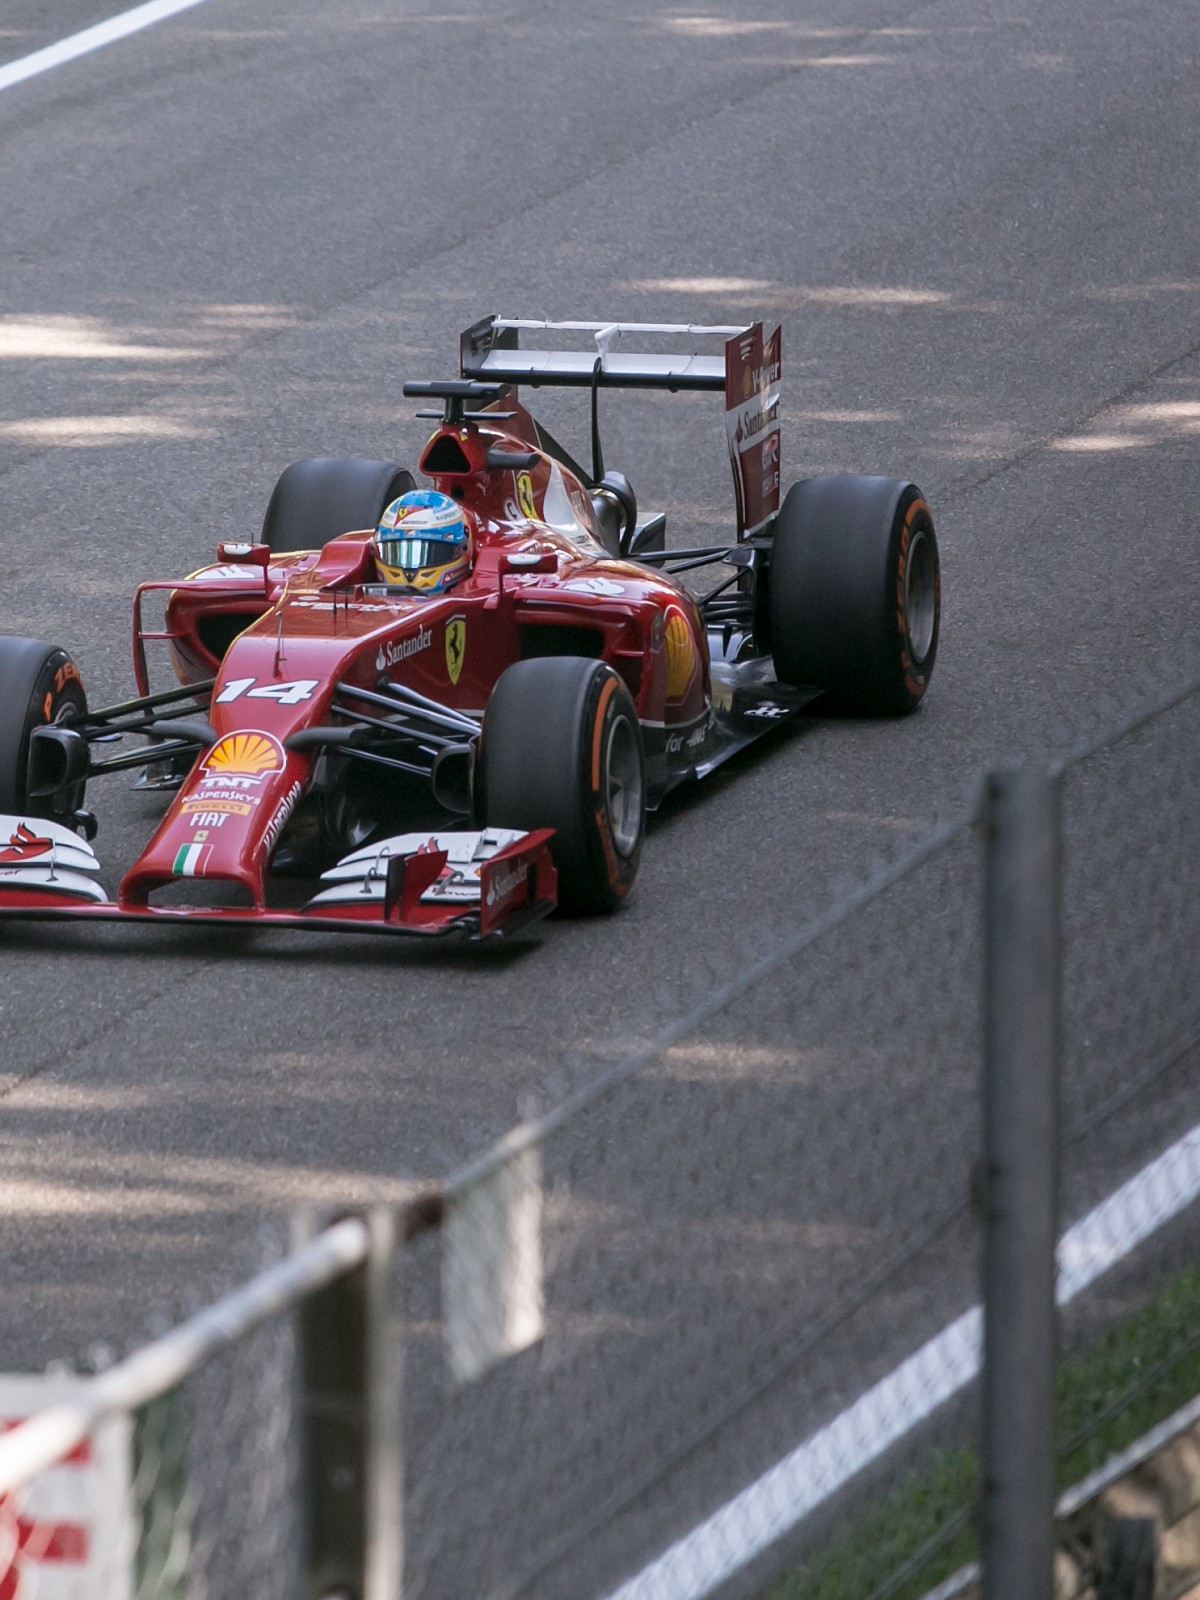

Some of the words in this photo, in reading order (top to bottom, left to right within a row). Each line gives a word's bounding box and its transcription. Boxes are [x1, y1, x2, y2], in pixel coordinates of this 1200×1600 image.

[385, 623, 433, 667] Santander
[215, 677, 320, 704] 14
[200, 777, 262, 789] TNT
[181, 790, 257, 804] KASPERSKY
[189, 812, 230, 828] FIAT
